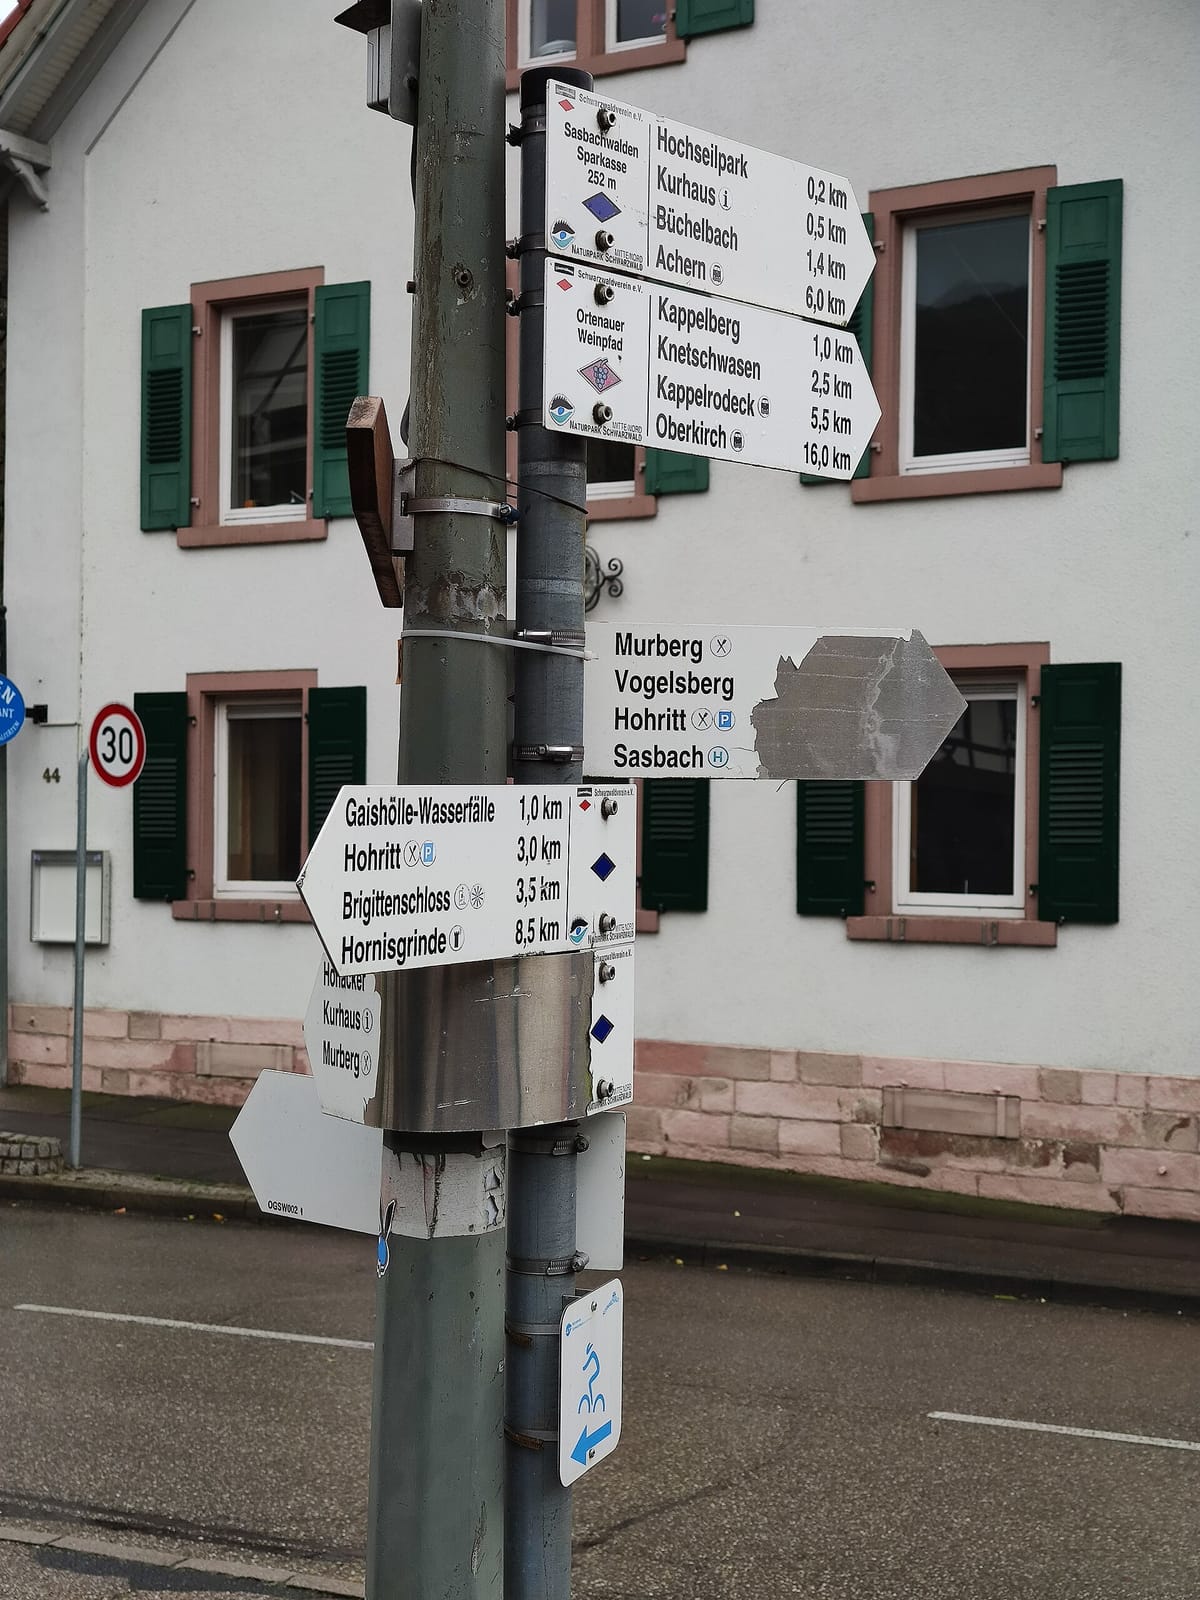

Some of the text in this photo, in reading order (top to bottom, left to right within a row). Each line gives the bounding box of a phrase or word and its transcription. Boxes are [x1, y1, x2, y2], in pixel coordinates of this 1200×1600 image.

[564, 122, 639, 158] Sasbachwalden
[577, 146, 627, 173] Sparkasse
[657, 126, 847, 210] Hochseilpark 0,2 km
[588, 169, 617, 190] 252 m
[657, 164, 716, 206] Kurhaus
[806, 212, 825, 240] 0,5
[828, 217, 846, 245] km
[656, 205, 846, 281] Büchelbach 1,4 km
[578, 270, 631, 290] Schwarzwaldverein
[656, 244, 845, 316] Achern 6,0 km
[576, 309, 625, 333] Ortenauer
[658, 296, 853, 365] Kappelberg 1,0 km
[577, 327, 623, 352] Weinpfad
[657, 335, 852, 400] Knetschwasen 2,5 km
[657, 374, 851, 435] Kappelrodeck 5,5 km
[656, 413, 851, 471] Oberkirch 16,0 km
[614, 632, 703, 664] Murberg
[614, 670, 734, 700] Vogelsberg
[614, 708, 687, 731] Hohritt
[102, 726, 132, 764] 30
[613, 744, 704, 769] Sasbach
[43, 768, 60, 783] 44
[345, 795, 562, 828] Gaishölle-Wasserfälle 1,0 km
[344, 842, 401, 872] Hohritt
[517, 836, 538, 866] 3,0
[541, 838, 561, 861] km
[342, 877, 560, 926] Brigittenschloss 3,5 km
[341, 918, 560, 966] Hornisgrinde 8,5 km
[323, 1000, 361, 1030] Kurhaus
[323, 1041, 360, 1078] Murberg
[268, 1201, 298, 1214] OGSW002
